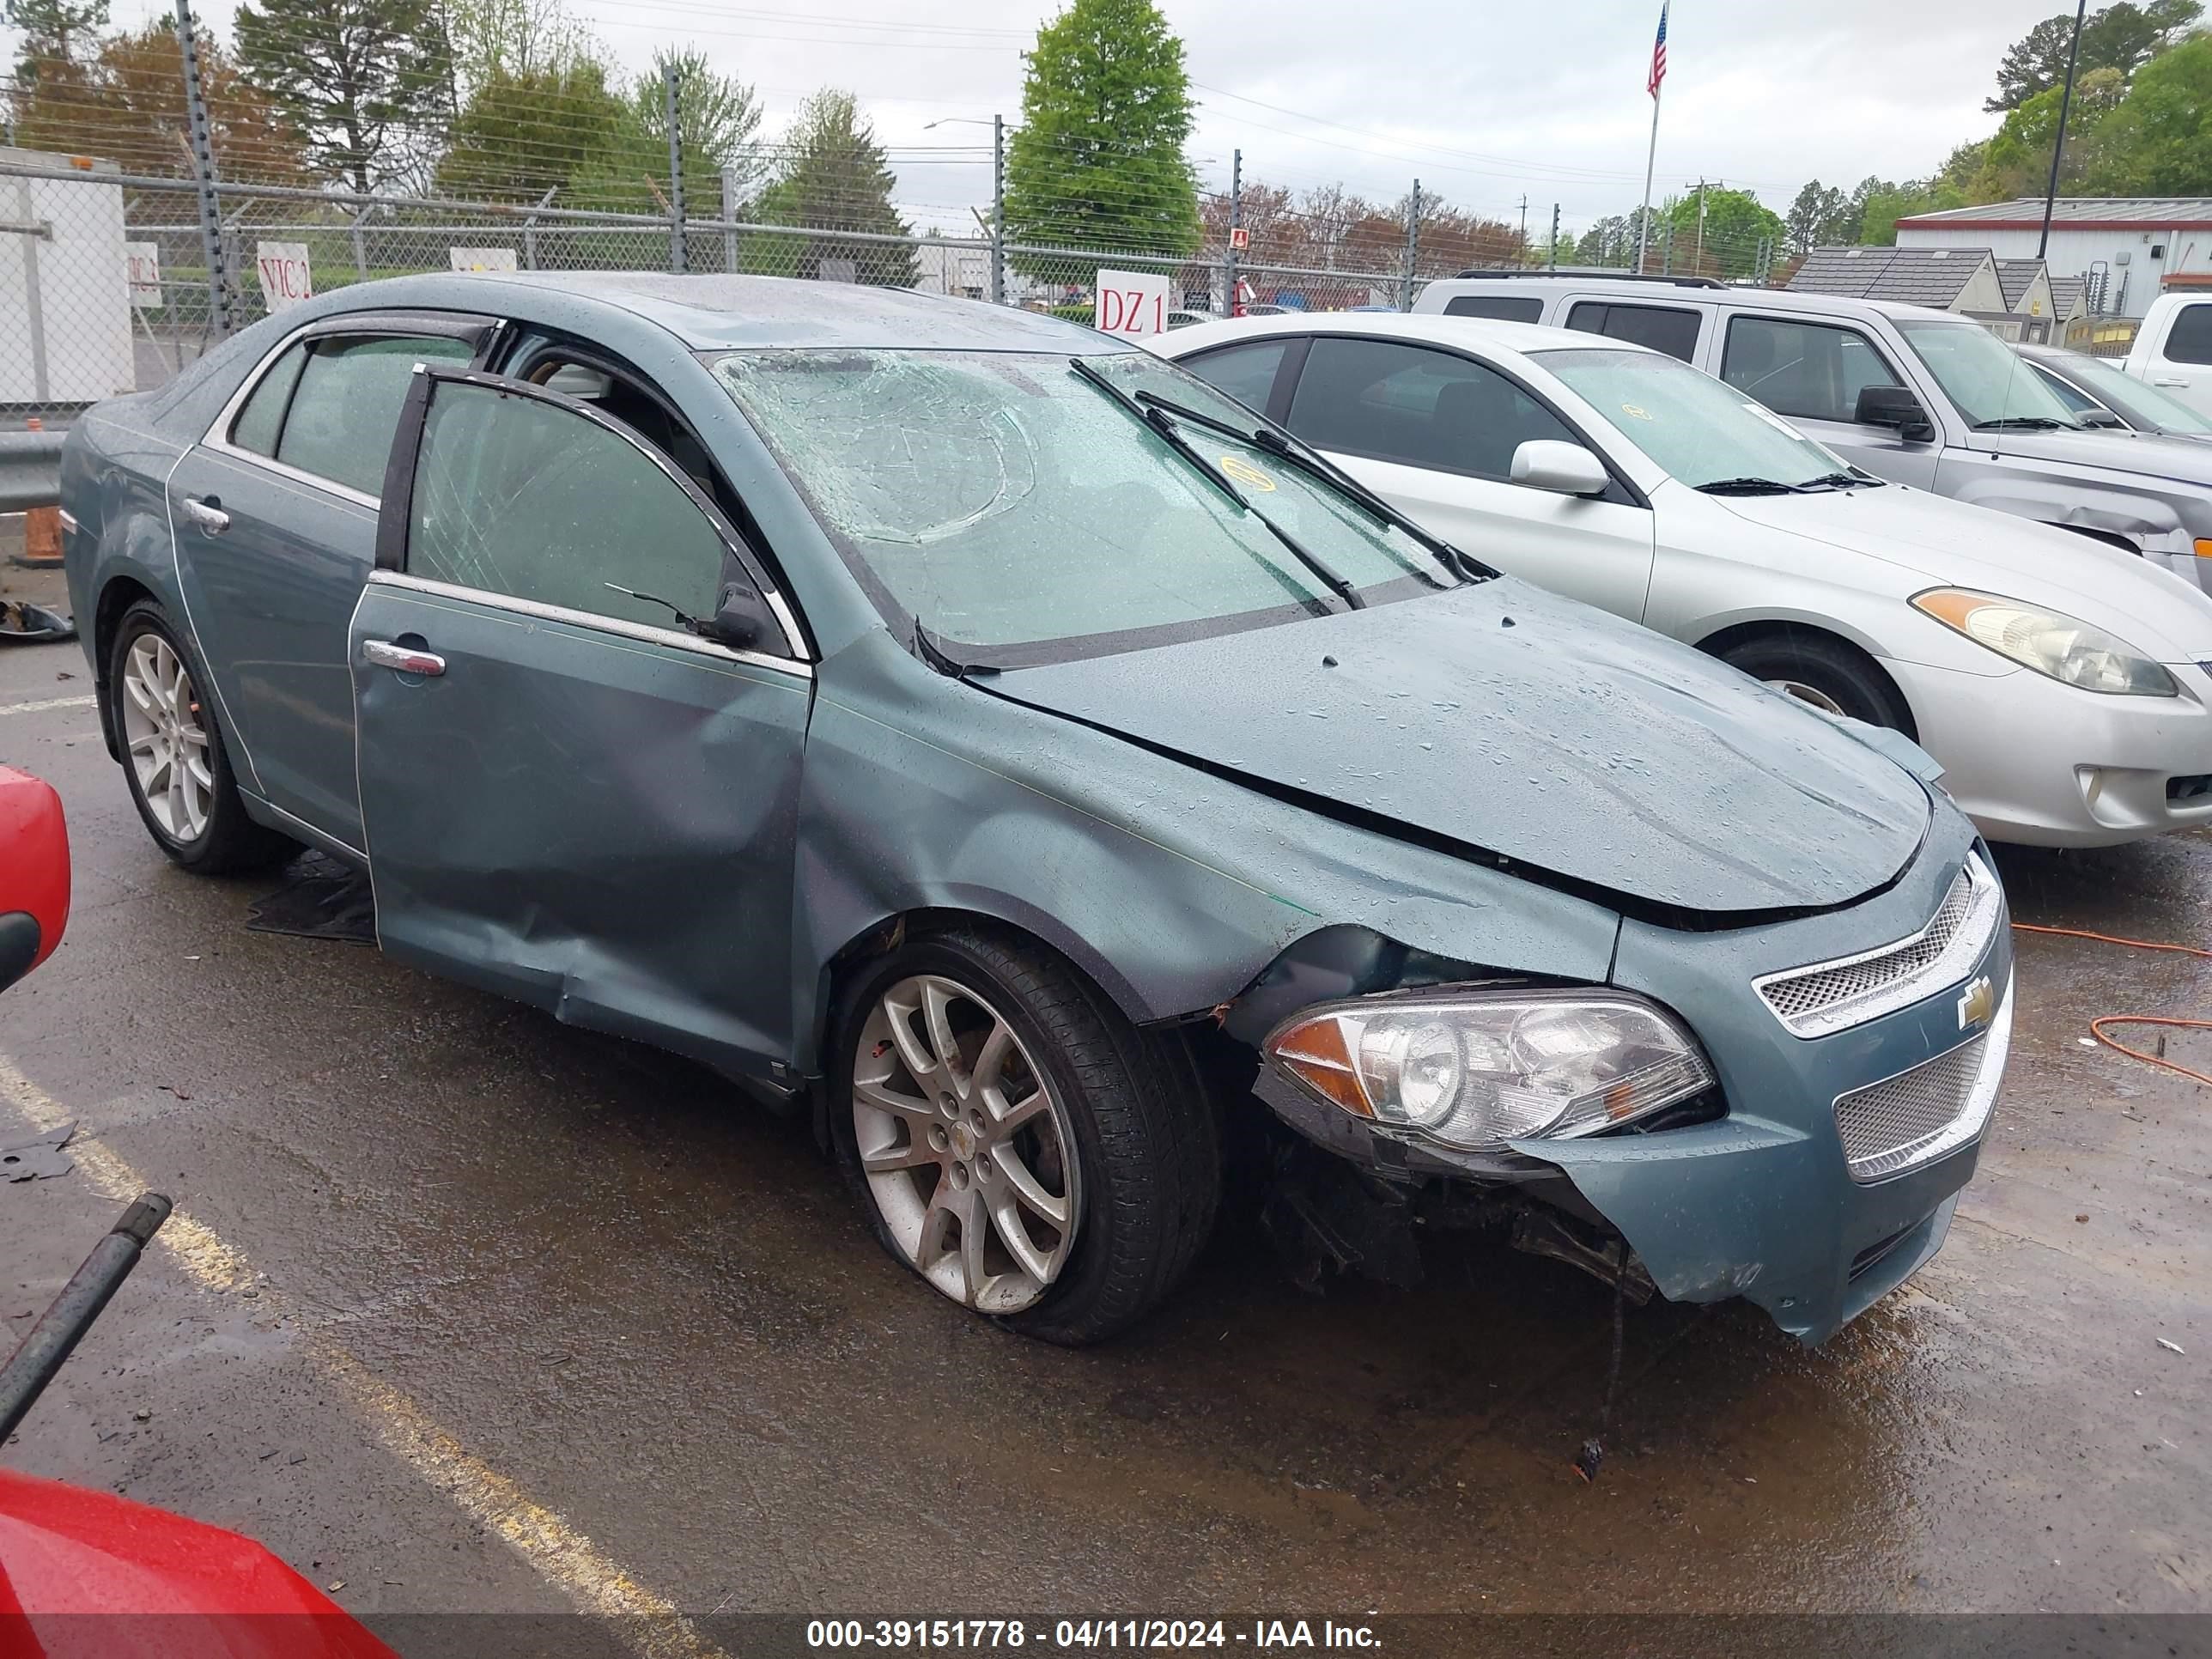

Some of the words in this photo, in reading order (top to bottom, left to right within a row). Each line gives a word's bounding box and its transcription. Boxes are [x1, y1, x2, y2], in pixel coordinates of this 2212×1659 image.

[260, 258, 298, 299] VIC
[1100, 289, 1144, 332] DZ
[1153, 293, 1164, 334] 1
